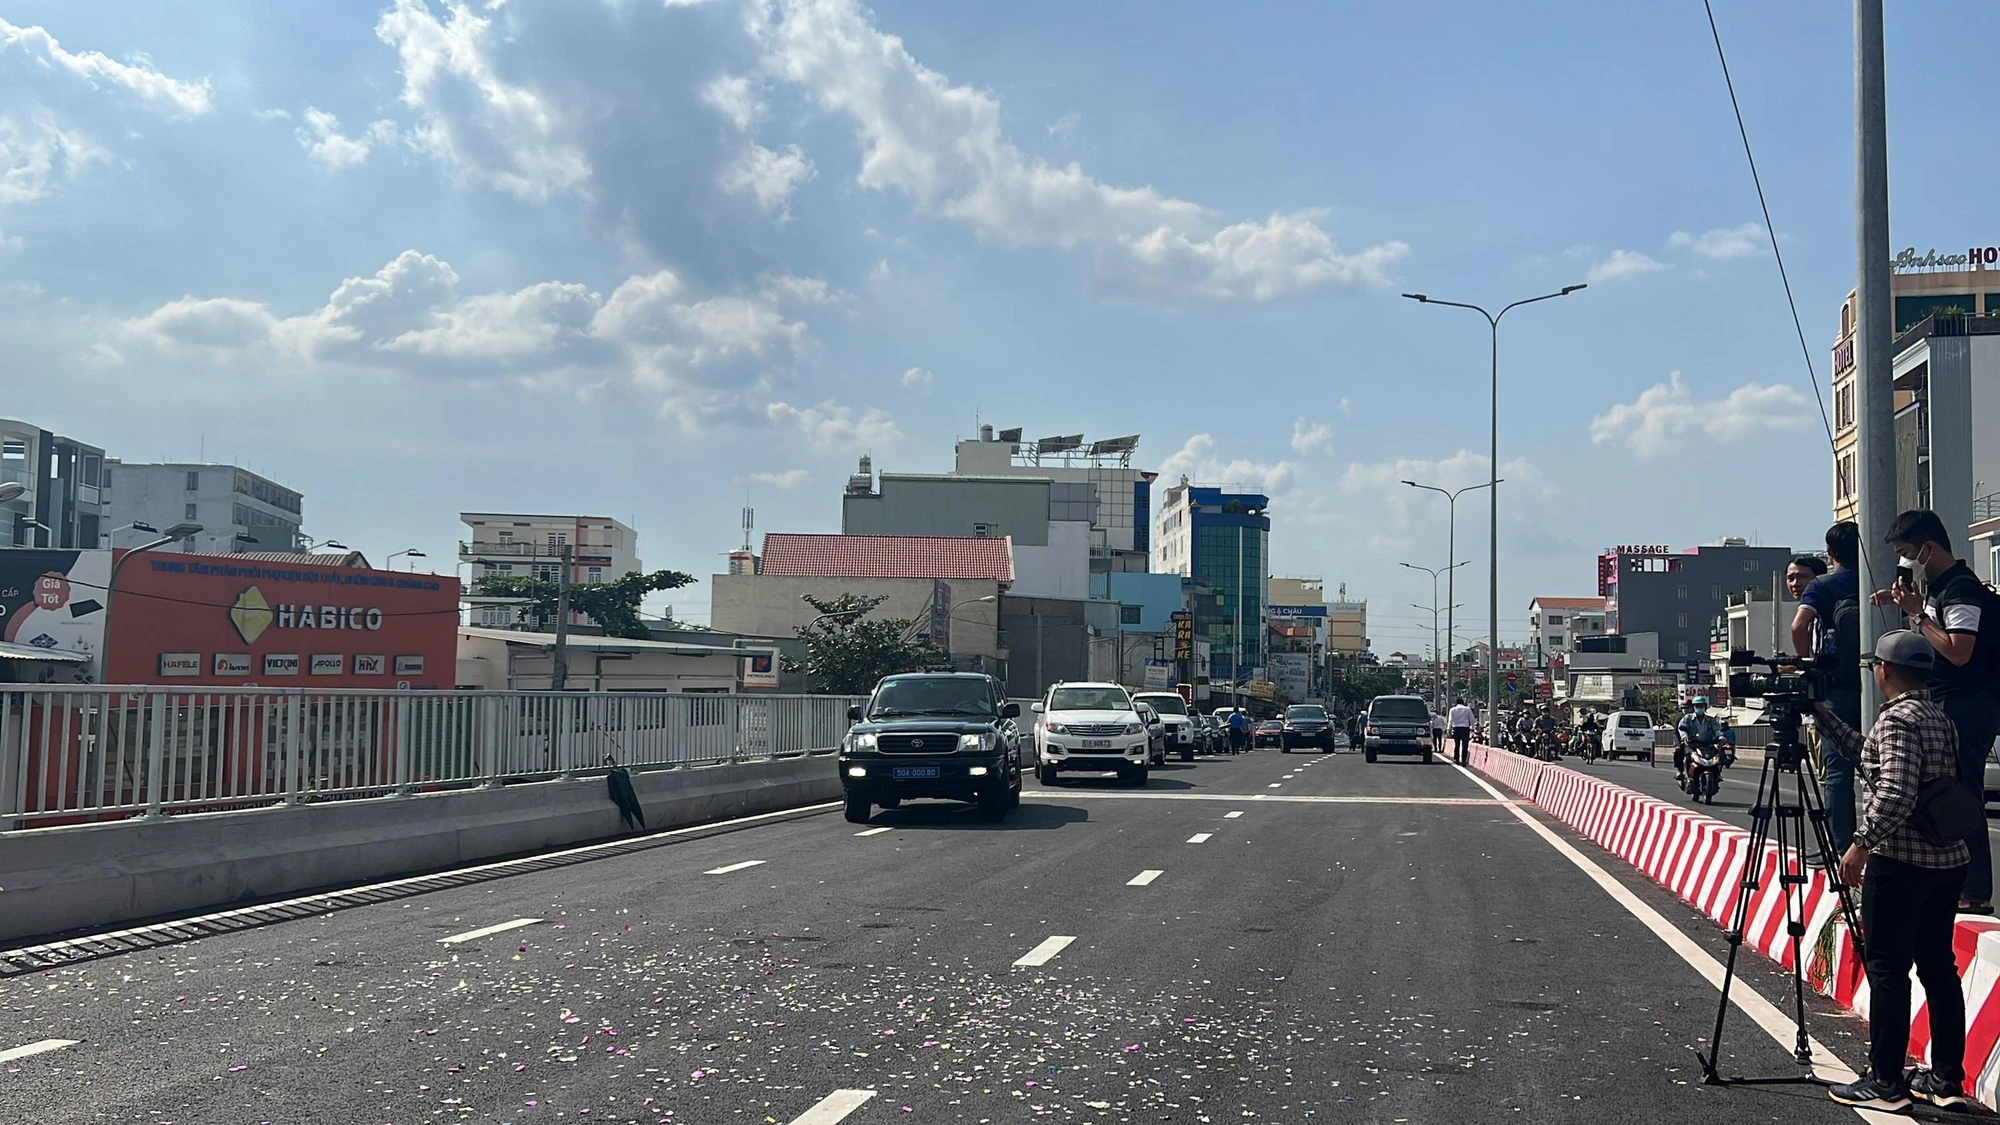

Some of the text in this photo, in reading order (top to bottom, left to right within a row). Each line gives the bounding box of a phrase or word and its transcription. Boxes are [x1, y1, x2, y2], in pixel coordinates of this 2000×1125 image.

[1969, 247, 2000, 264] HO
[1616, 545, 1669, 554] MASSAGE
[42, 592, 60, 604] Tốt
[278, 603, 382, 631] HABICO
[1177, 620, 1191, 629] KA
[1177, 630, 1191, 639] RA
[1177, 650, 1191, 659] KE
